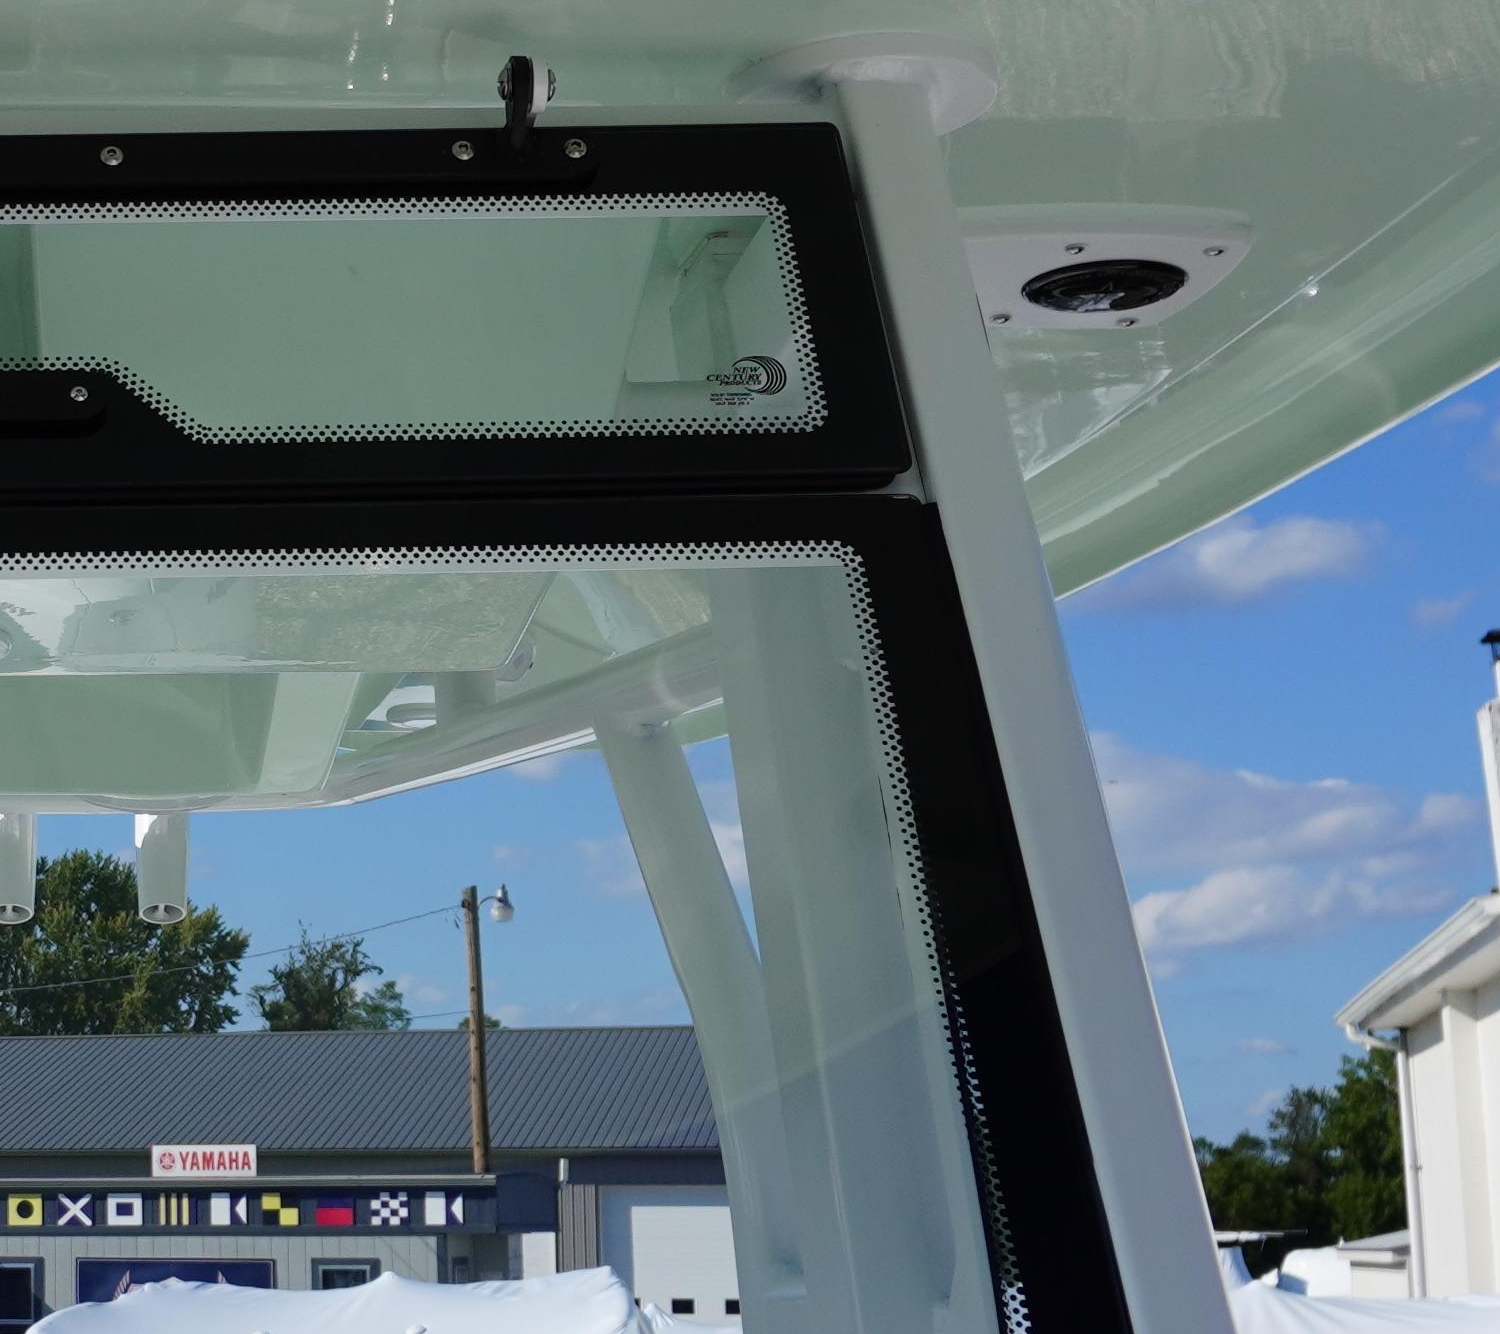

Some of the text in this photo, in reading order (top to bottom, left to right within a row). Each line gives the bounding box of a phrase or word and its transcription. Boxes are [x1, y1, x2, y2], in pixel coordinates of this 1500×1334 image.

[733, 366, 761, 374] NEW
[706, 373, 763, 382] CENTURY
[179, 1151, 252, 1171] YAMAHA
